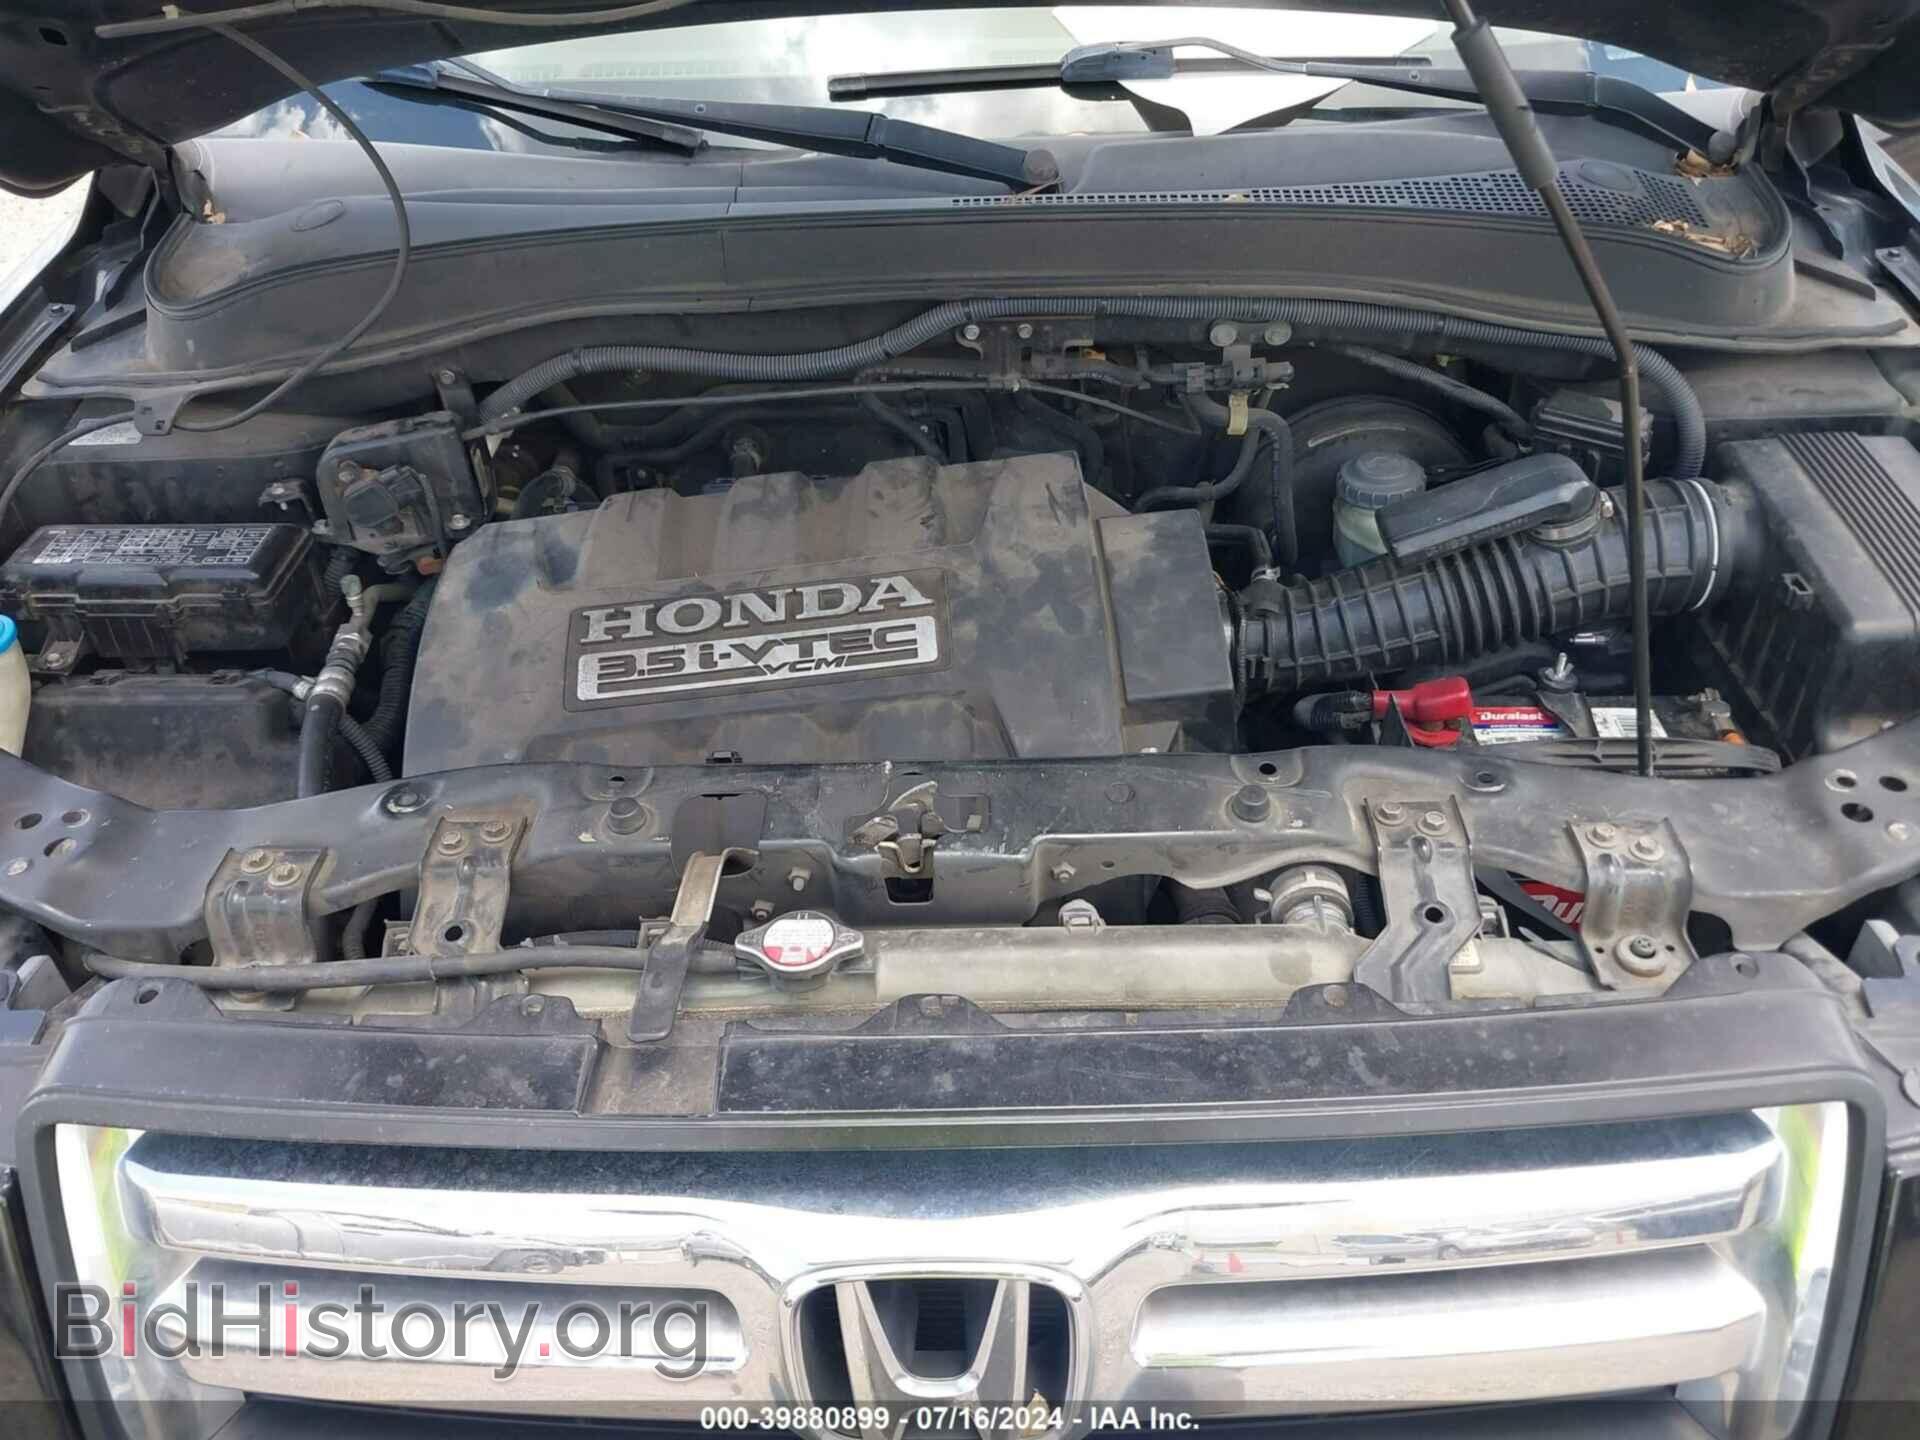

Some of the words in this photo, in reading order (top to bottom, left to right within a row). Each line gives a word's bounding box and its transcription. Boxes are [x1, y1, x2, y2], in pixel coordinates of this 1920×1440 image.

[580, 576, 934, 644] HONDA
[597, 650, 686, 681] 3.5
[698, 623, 918, 669] i-VTEC
[763, 655, 848, 675] VCM
[1476, 711, 1544, 720] Duralast
